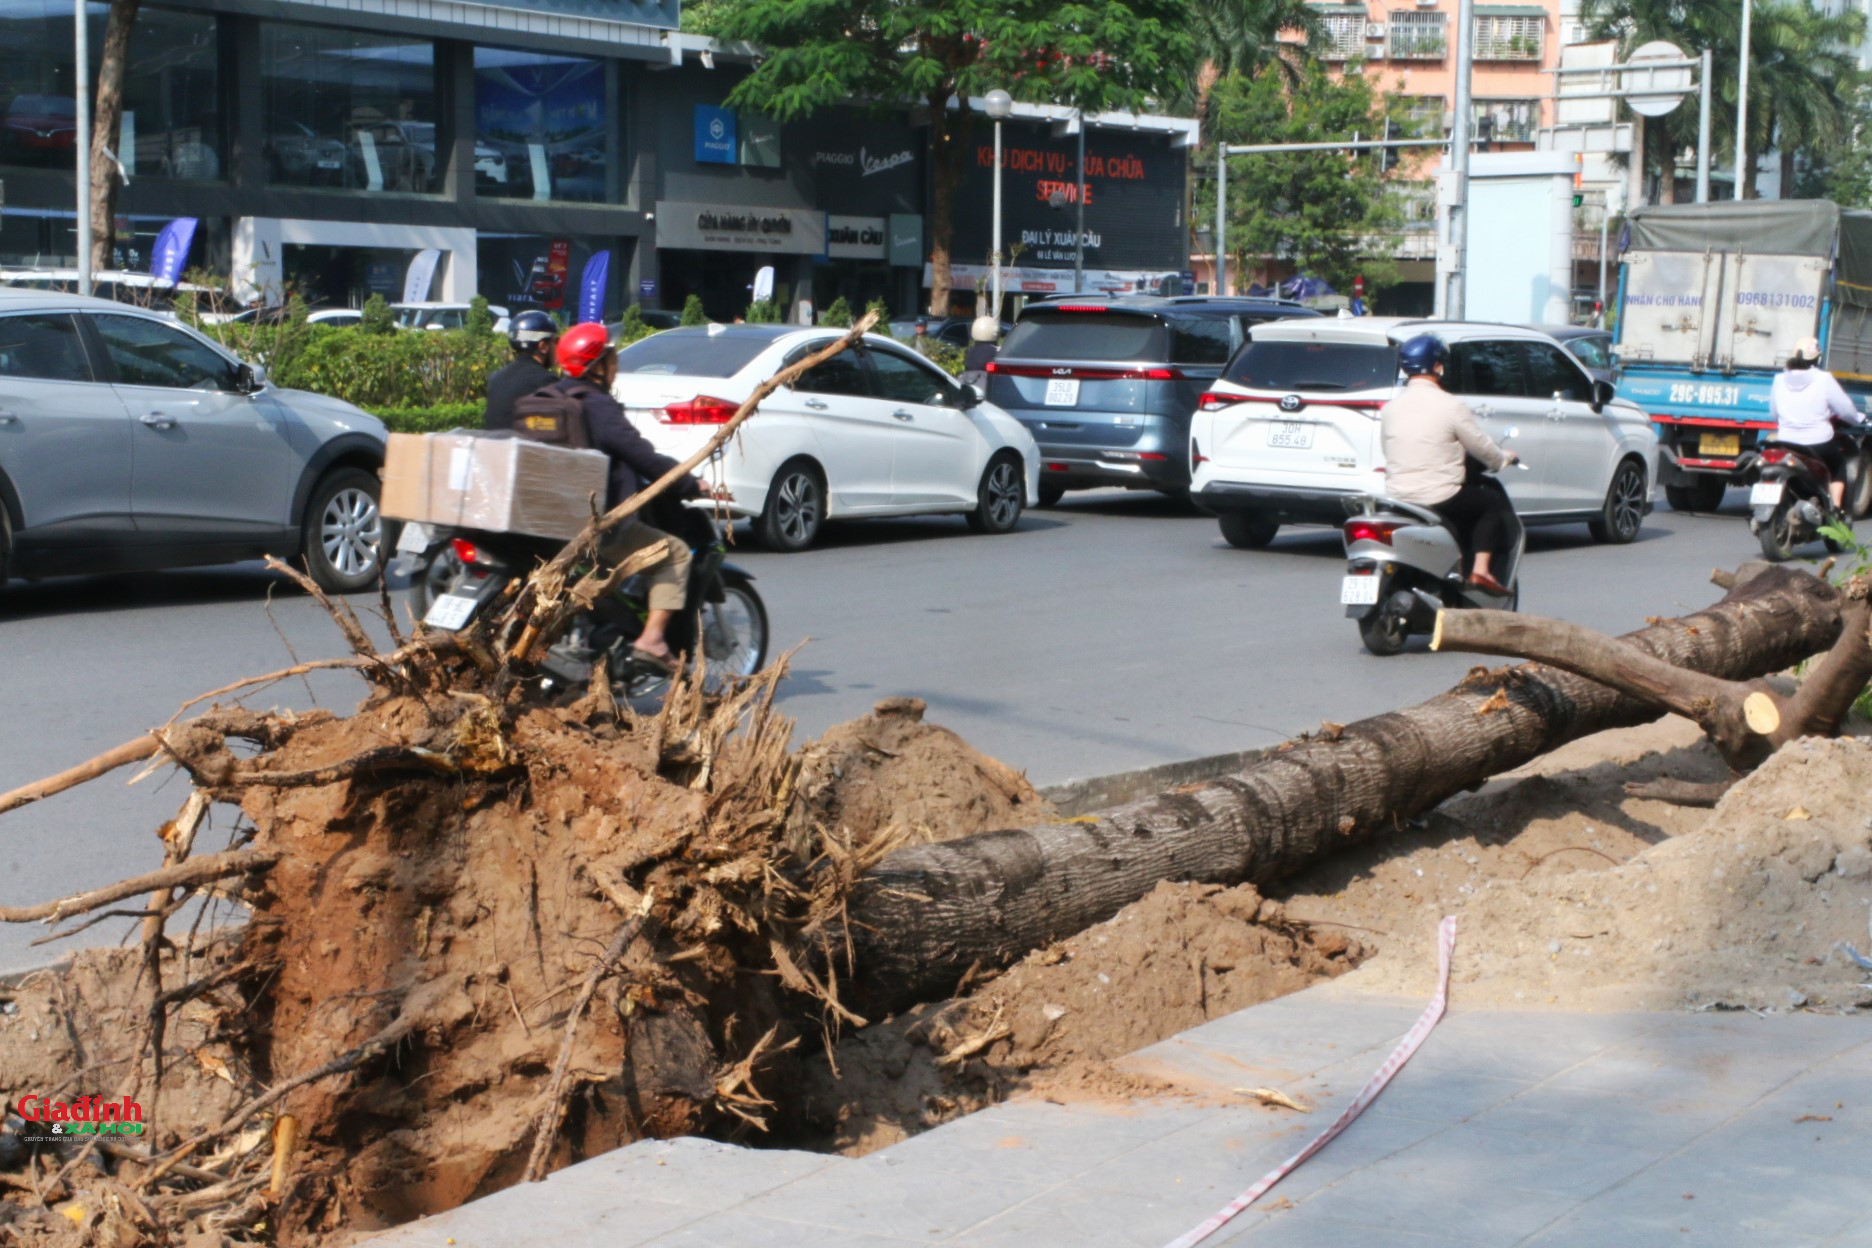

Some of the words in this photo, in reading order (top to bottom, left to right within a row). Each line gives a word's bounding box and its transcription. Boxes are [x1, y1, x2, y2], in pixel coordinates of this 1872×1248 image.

[816, 152, 854, 165] PIAGGIO
[860, 146, 914, 176] Vespa
[1011, 149, 1043, 174] DỊCH
[1077, 150, 1104, 177] ỬA
[1108, 154, 1145, 179] CHỮA
[588, 280, 597, 323] INFAST
[1737, 292, 1815, 309] 0968131002
[1669, 384, 1739, 405] 29C-895.31
[1282, 423, 1302, 434] 30H
